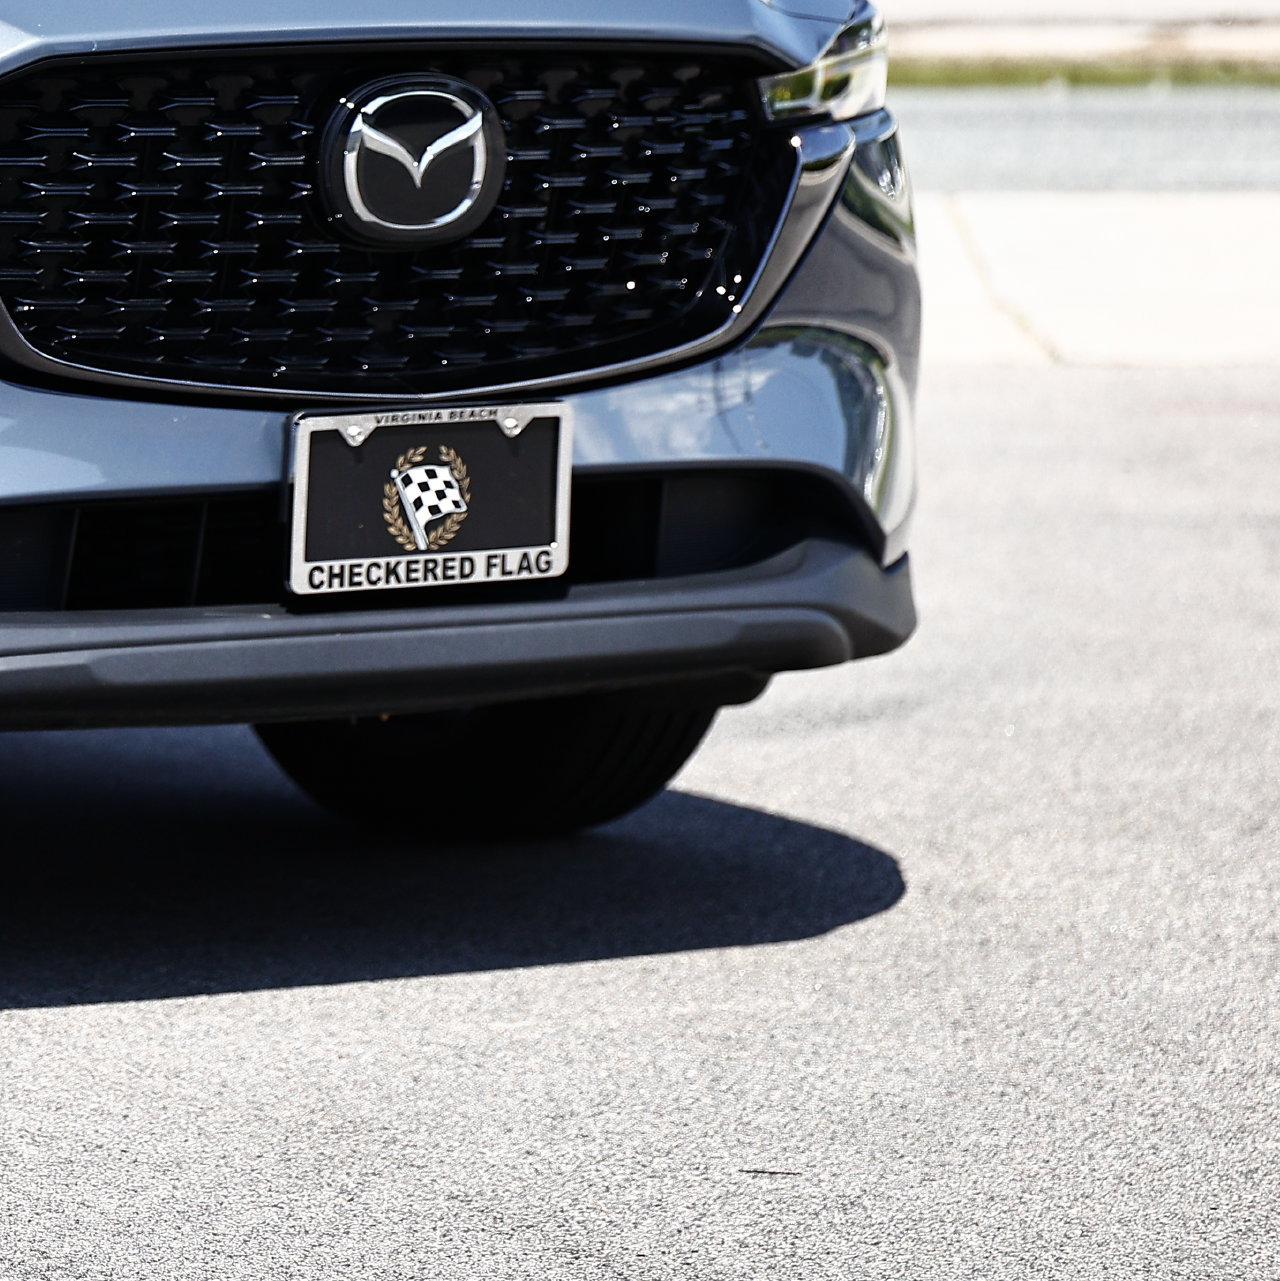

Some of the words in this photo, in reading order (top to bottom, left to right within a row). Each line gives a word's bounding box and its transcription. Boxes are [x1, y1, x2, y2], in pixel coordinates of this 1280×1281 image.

[375, 411, 443, 424] VIRGINIA
[448, 408, 498, 420] BEACH
[307, 556, 476, 591] CHECKERED
[485, 550, 554, 579] FLAG
